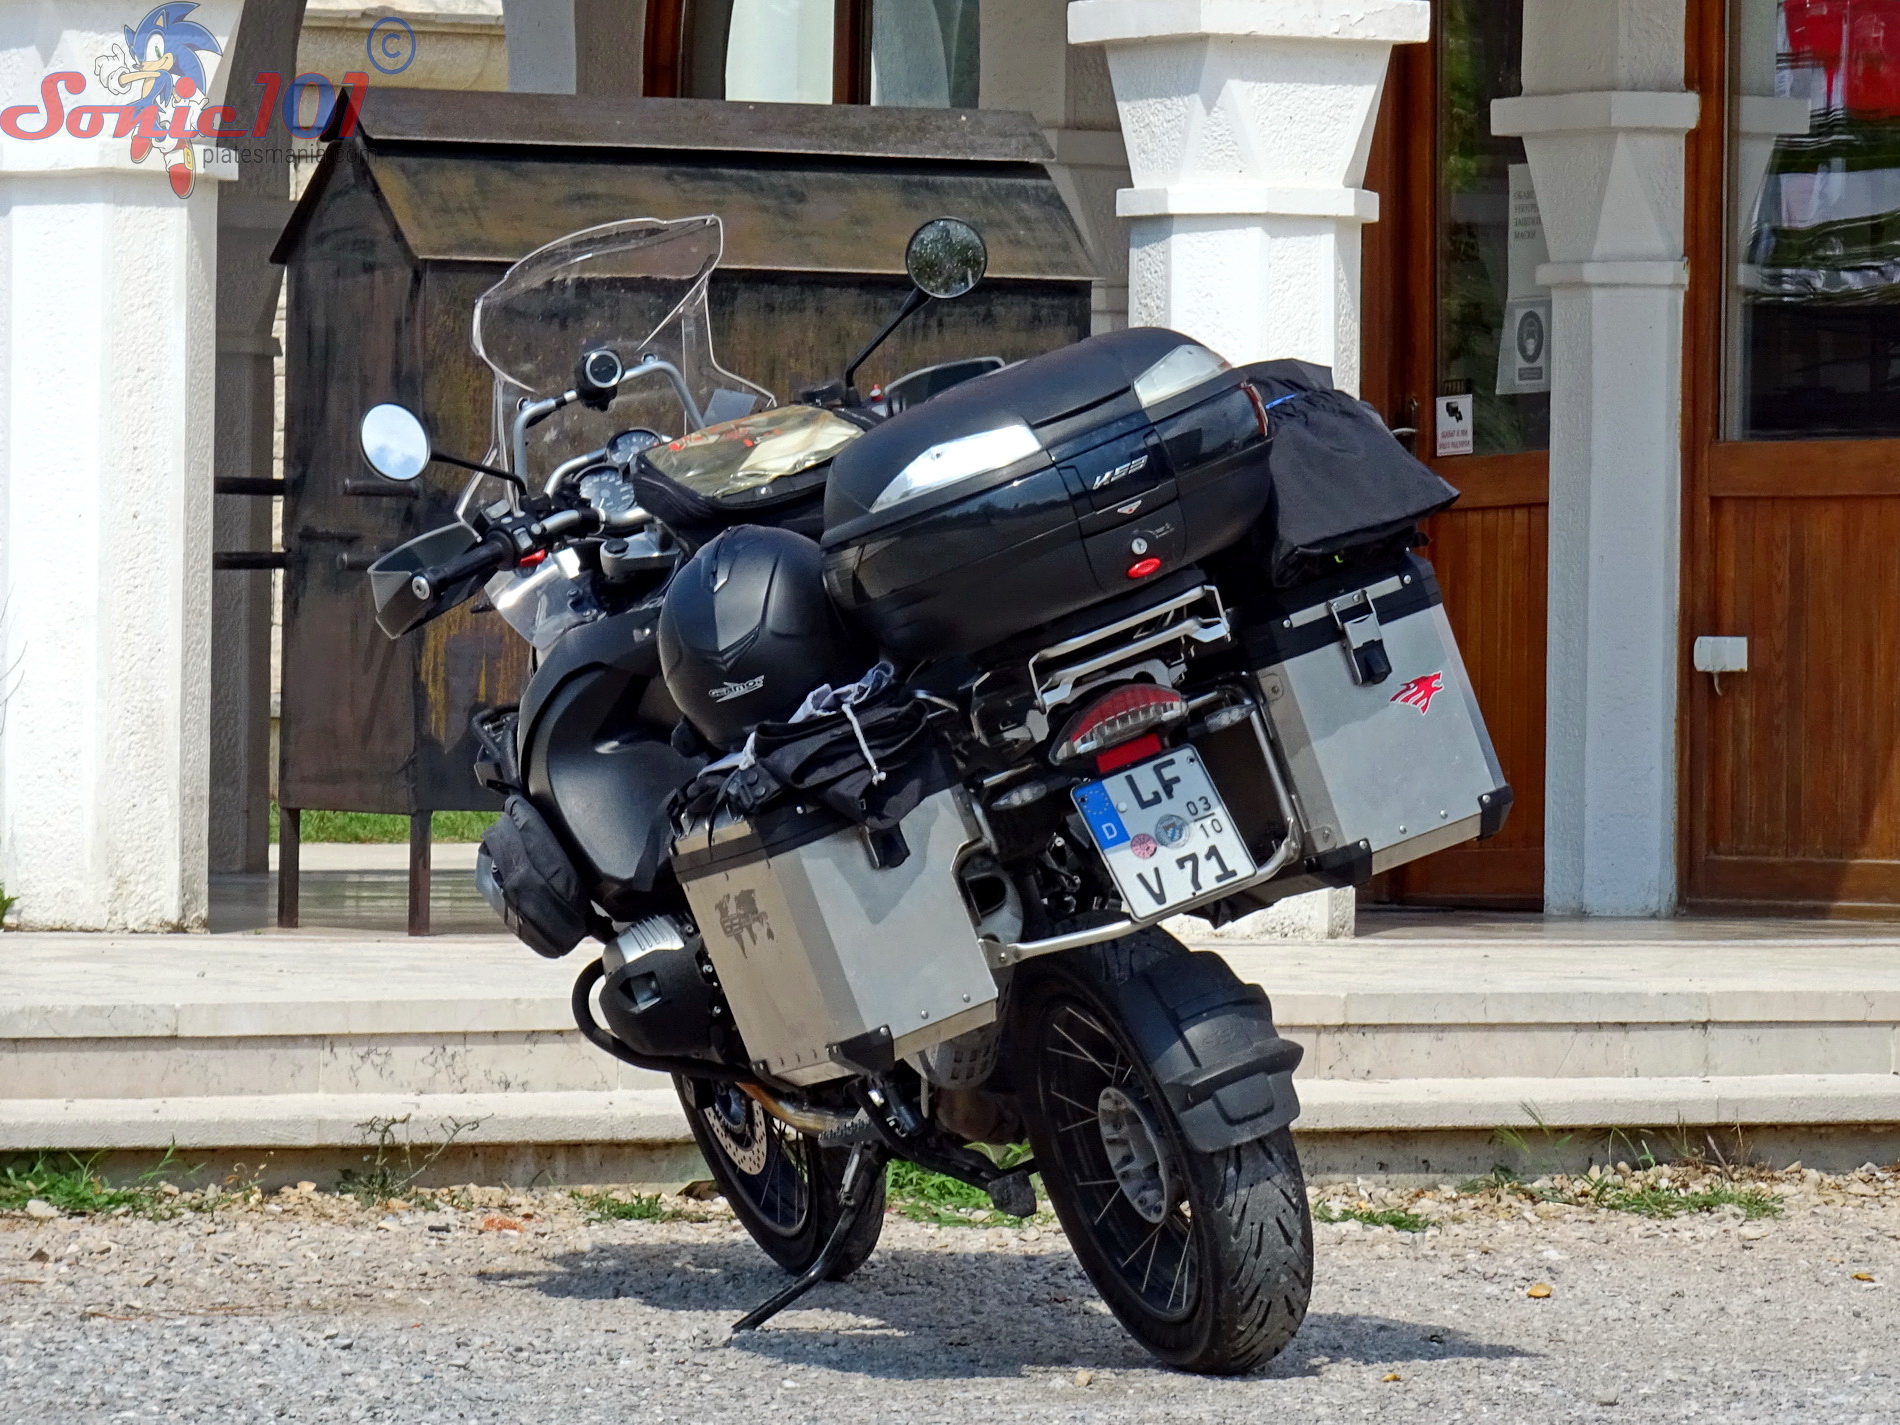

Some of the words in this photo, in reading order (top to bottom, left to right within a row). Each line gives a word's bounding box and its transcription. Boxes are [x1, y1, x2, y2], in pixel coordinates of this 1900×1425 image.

[1125, 758, 1181, 810] LF
[1186, 796, 1212, 817] 03
[1102, 822, 1118, 840] D
[1199, 818, 1223, 839] 10
[1136, 866, 1167, 906] V
[1175, 844, 1238, 892] 71
